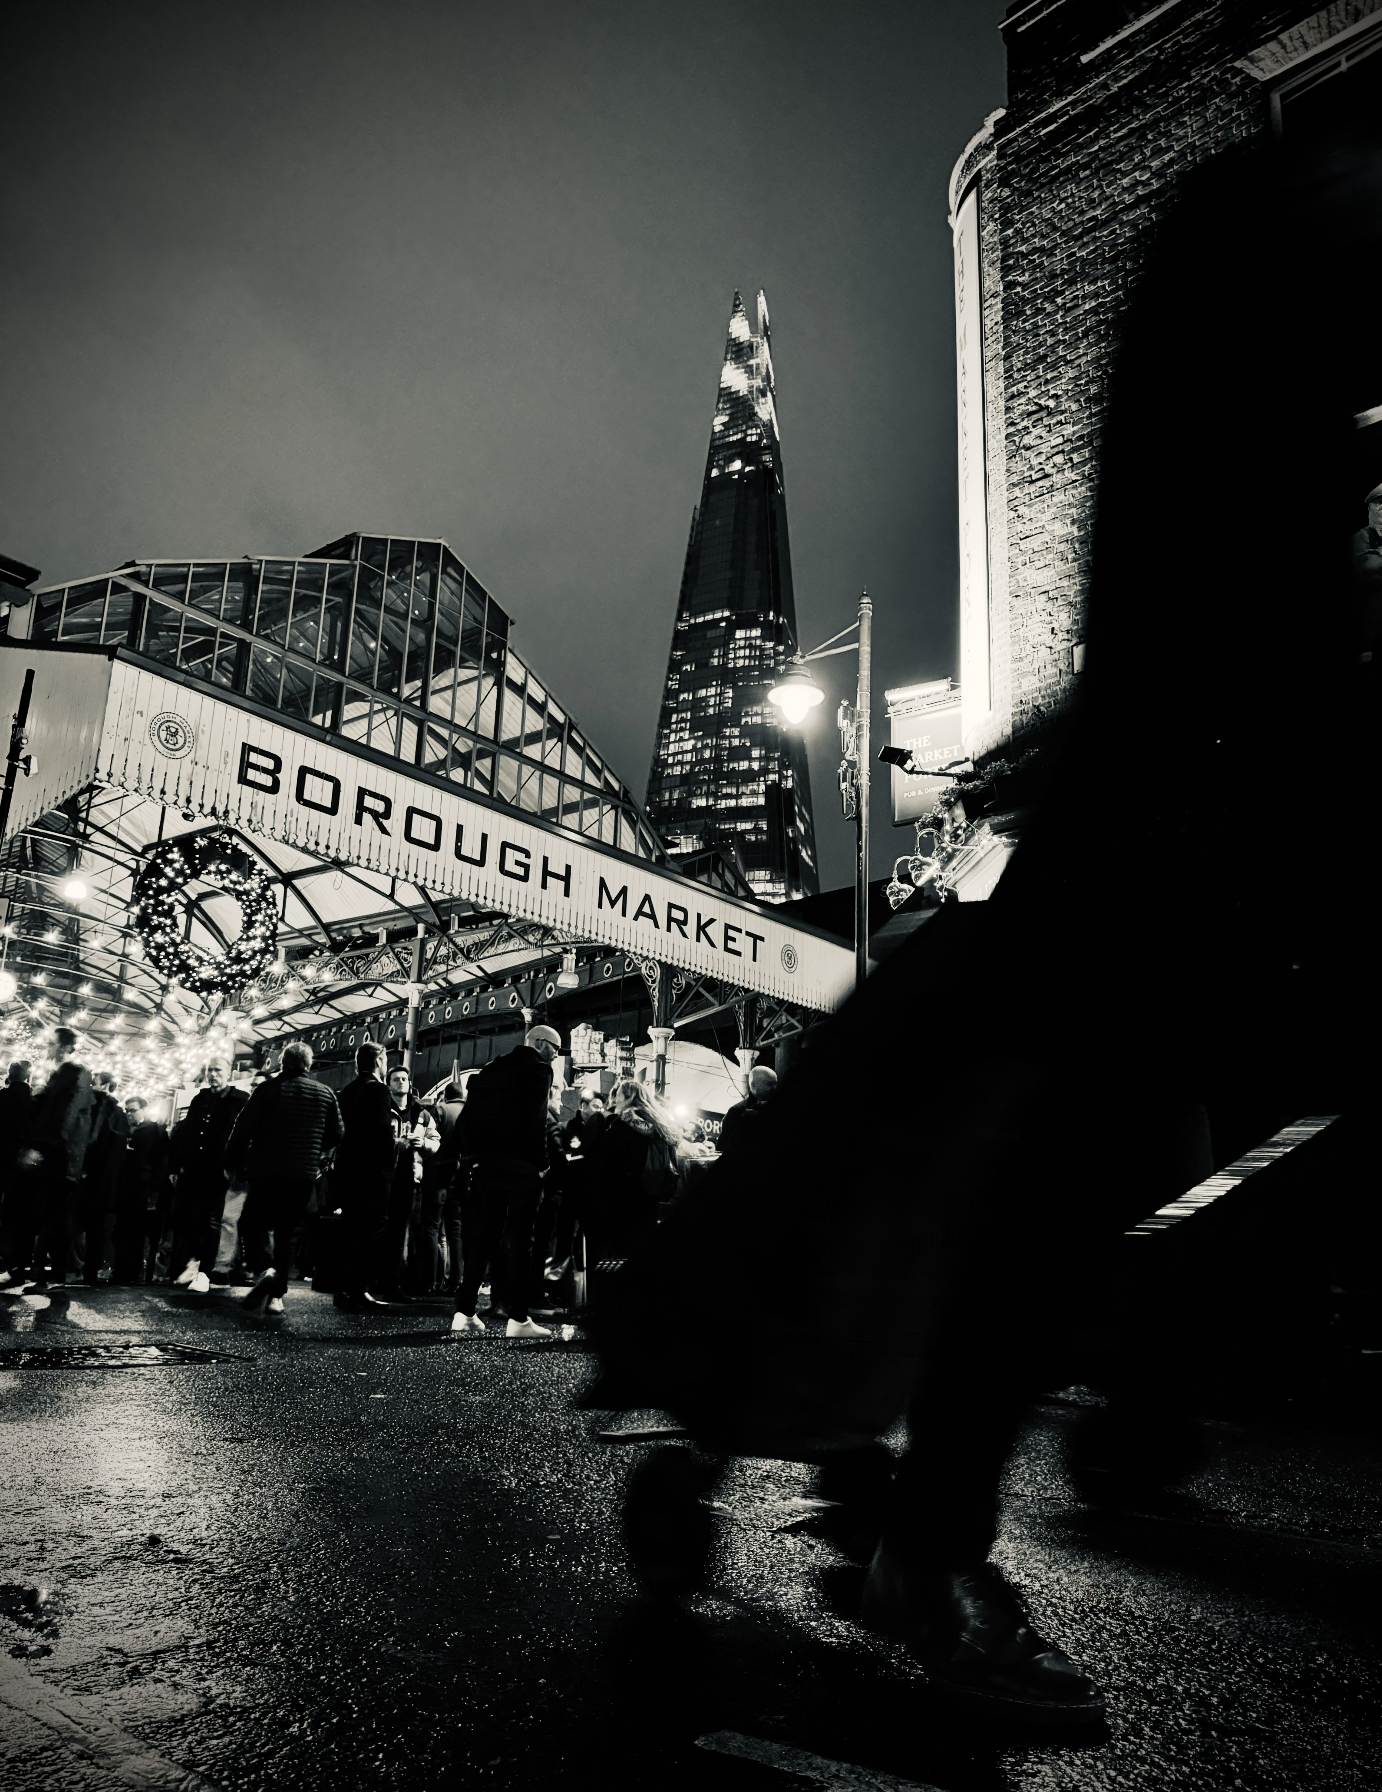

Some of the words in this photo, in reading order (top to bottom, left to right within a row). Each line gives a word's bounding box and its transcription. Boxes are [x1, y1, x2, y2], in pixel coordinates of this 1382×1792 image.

[903, 735, 931, 750] THE
[903, 790, 917, 799] PUB
[237, 741, 572, 898] BOROUGH
[597, 876, 766, 963] MARKET
